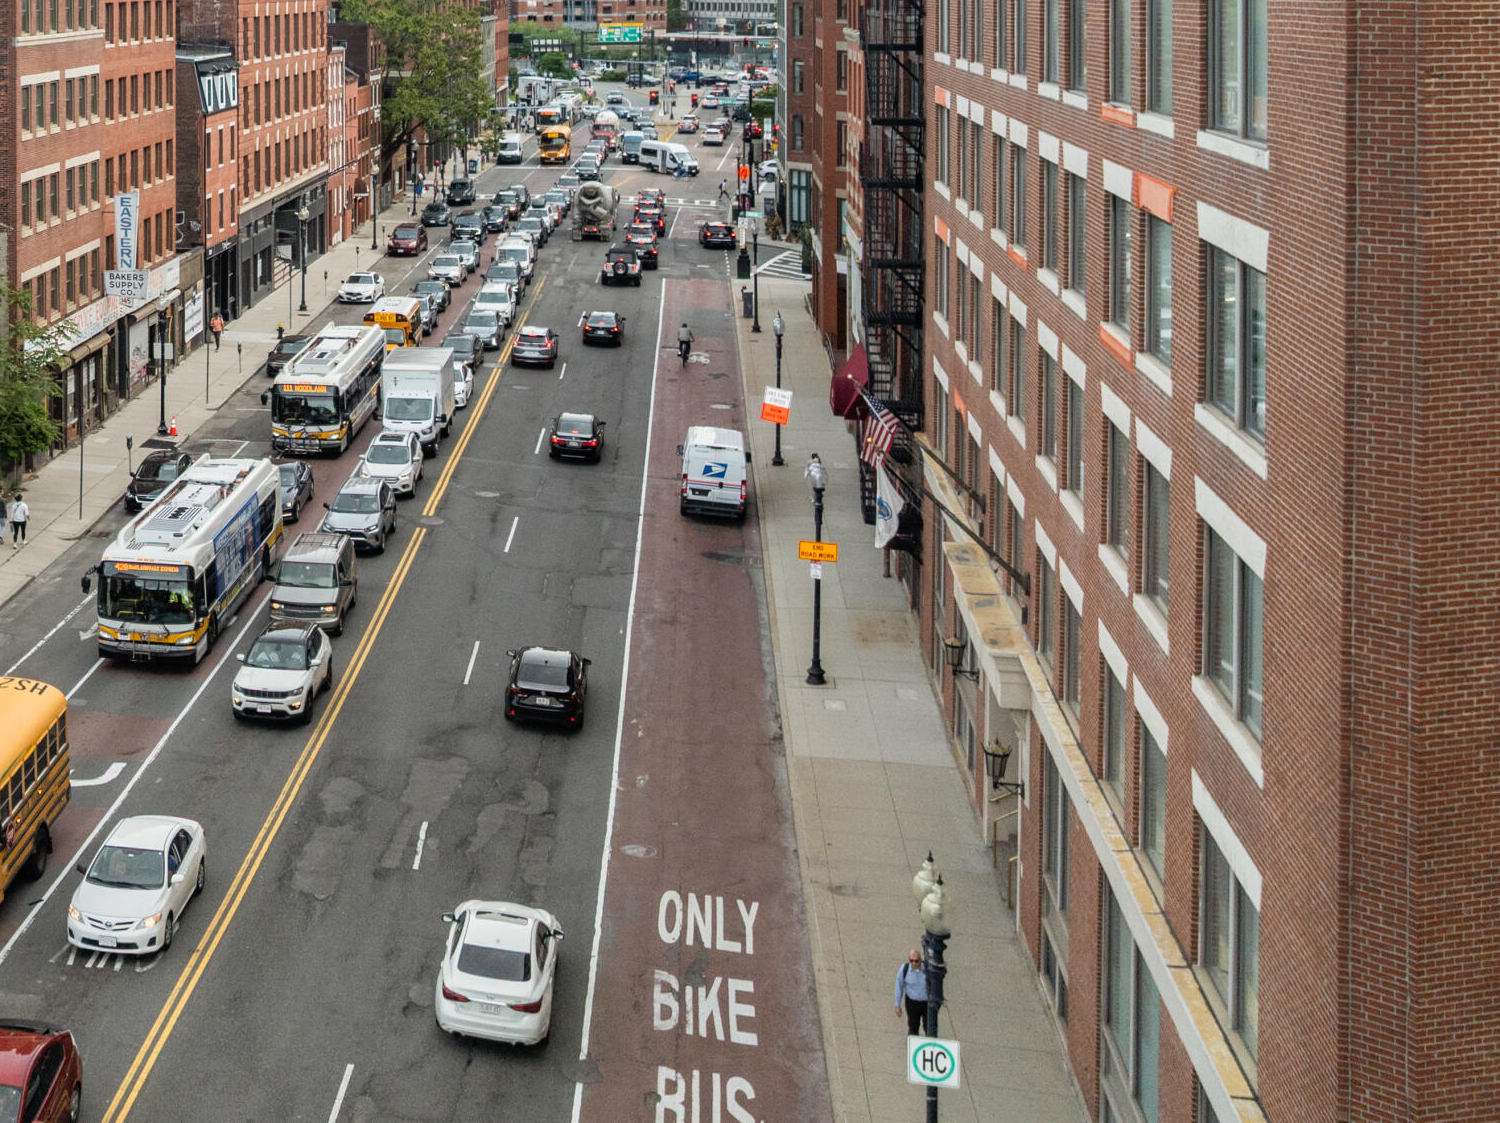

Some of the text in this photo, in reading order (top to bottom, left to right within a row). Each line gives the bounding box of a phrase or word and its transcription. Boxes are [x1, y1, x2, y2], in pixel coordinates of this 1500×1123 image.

[120, 197, 132, 268] EASTERN
[109, 273, 145, 282] BAKERS
[109, 281, 144, 290] SUPPLY
[120, 289, 136, 297] CO.
[658, 890, 759, 954] ONLY
[653, 969, 758, 1046] BIKE
[922, 1049, 947, 1074] HC
[655, 1065, 756, 1123] BUS
